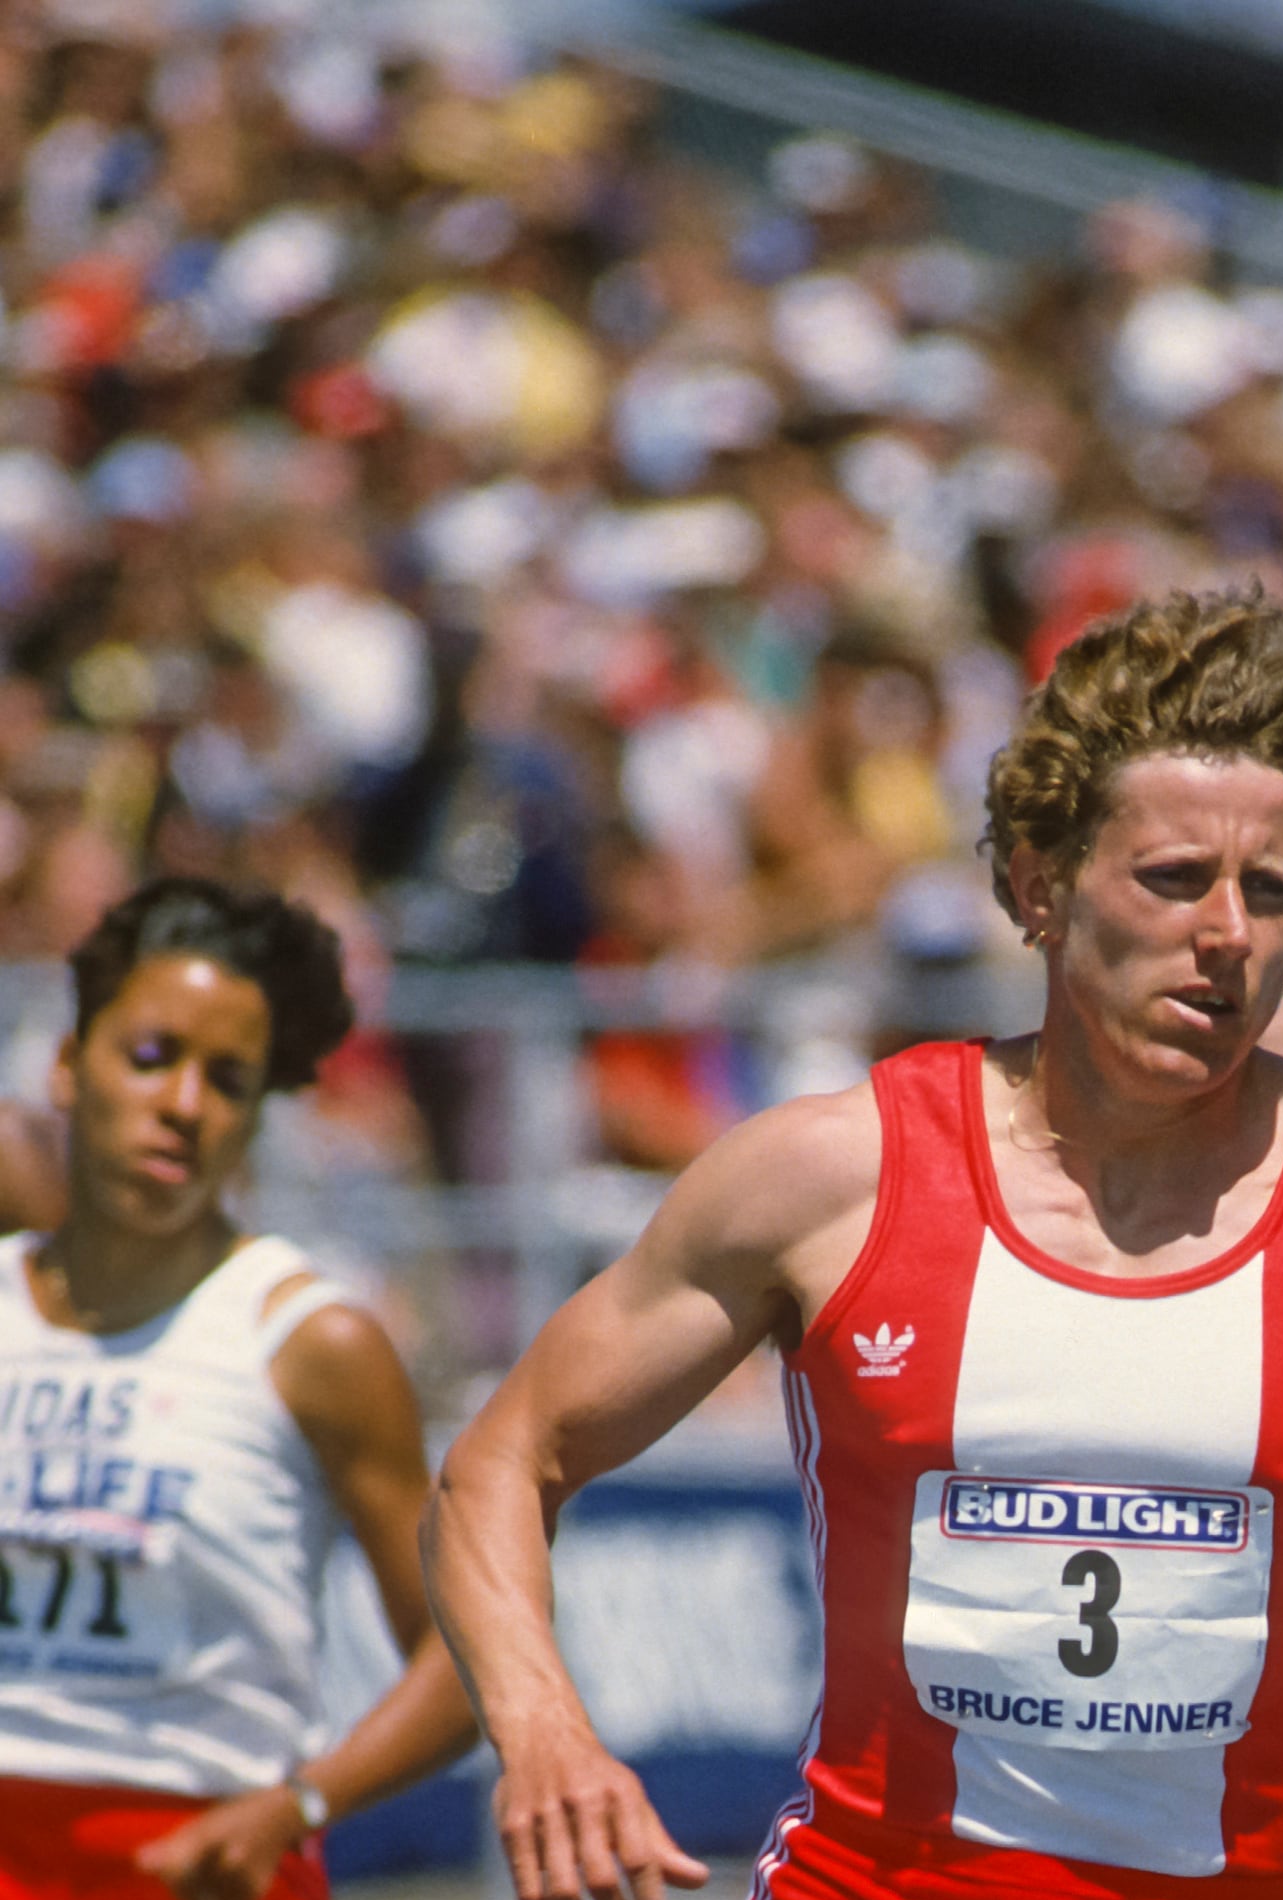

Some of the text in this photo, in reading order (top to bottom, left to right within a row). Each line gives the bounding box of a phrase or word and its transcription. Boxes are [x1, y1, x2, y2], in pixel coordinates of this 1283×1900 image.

[955, 1489, 1235, 1537] BUD LIGHT
[1057, 1549, 1122, 1678] 3
[928, 1684, 1233, 1734] BRUCE JENNER
